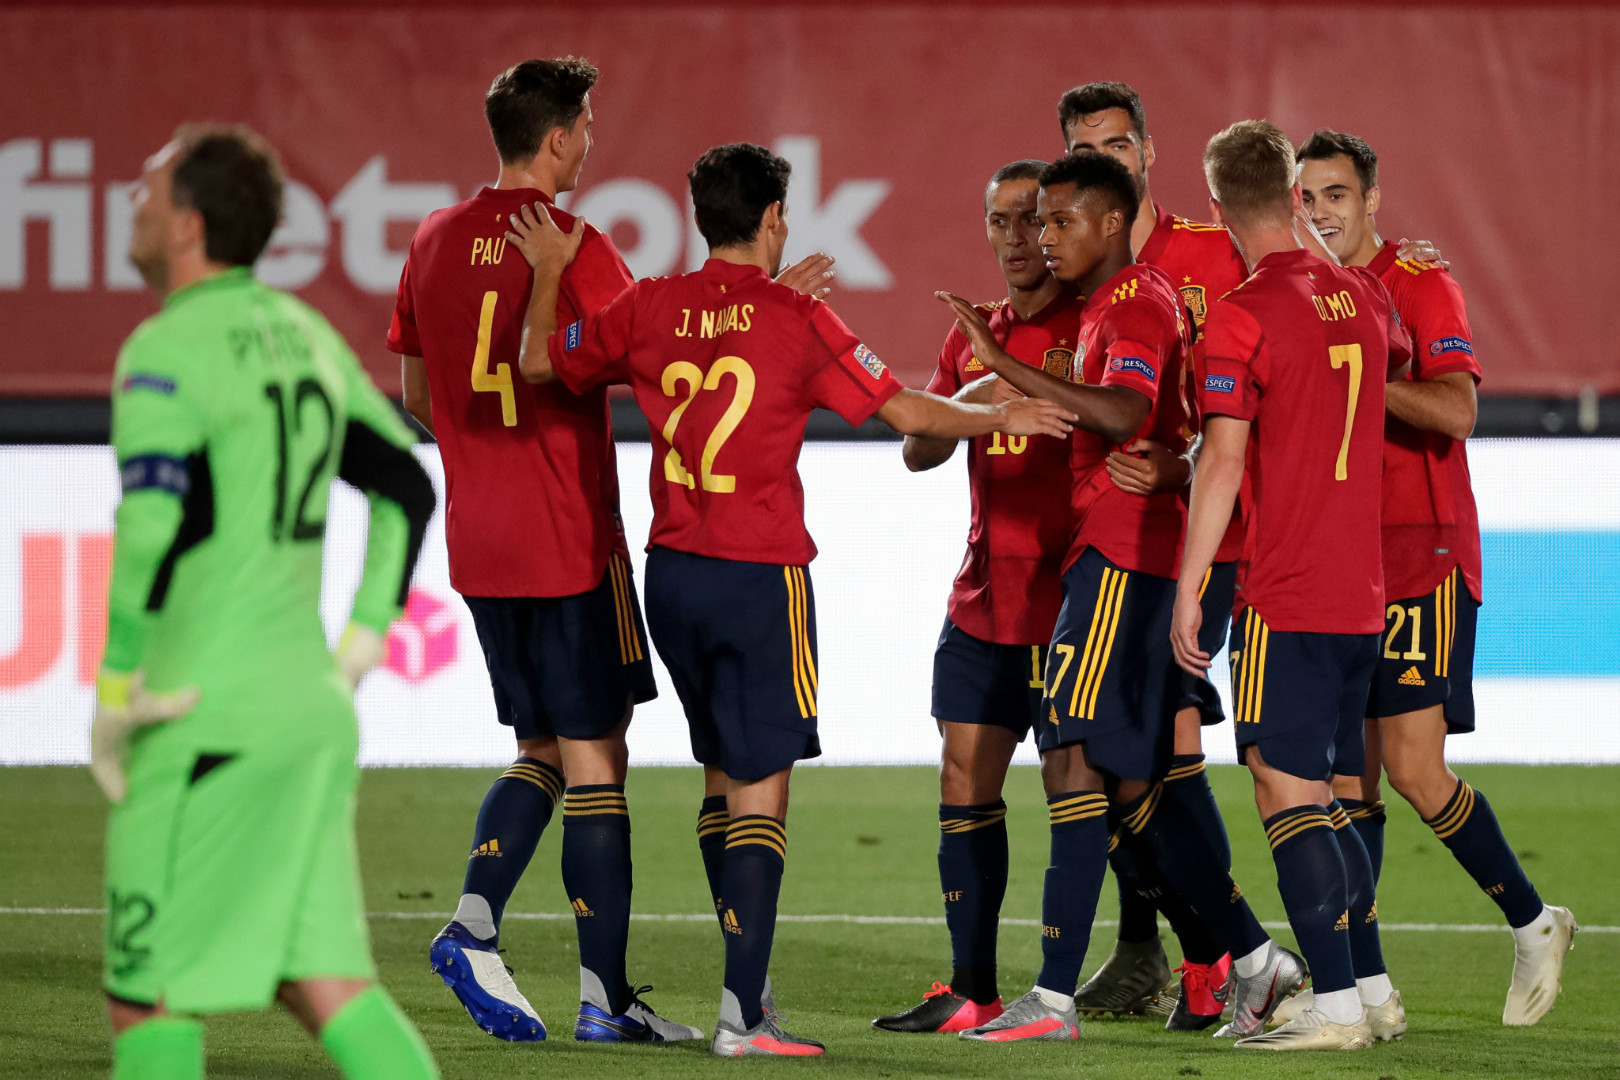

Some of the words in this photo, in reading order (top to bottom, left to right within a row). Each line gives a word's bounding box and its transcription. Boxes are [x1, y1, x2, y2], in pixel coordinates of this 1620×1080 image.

[471, 237, 506, 265] PAU
[1311, 290, 1357, 321] OLMO
[675, 309, 693, 337] J.
[700, 304, 755, 339] NAVAS
[471, 290, 518, 427] 4
[1443, 339, 1472, 350] RESPECT
[964, 364, 984, 373] adidas
[1124, 360, 1155, 377] RESPECT
[661, 355, 756, 493] 22
[1328, 343, 1363, 481] 7
[265, 379, 334, 542] 12
[1384, 604, 1426, 660] 21
[1397, 677, 1426, 686] adidas
[942, 891, 963, 902] FEF
